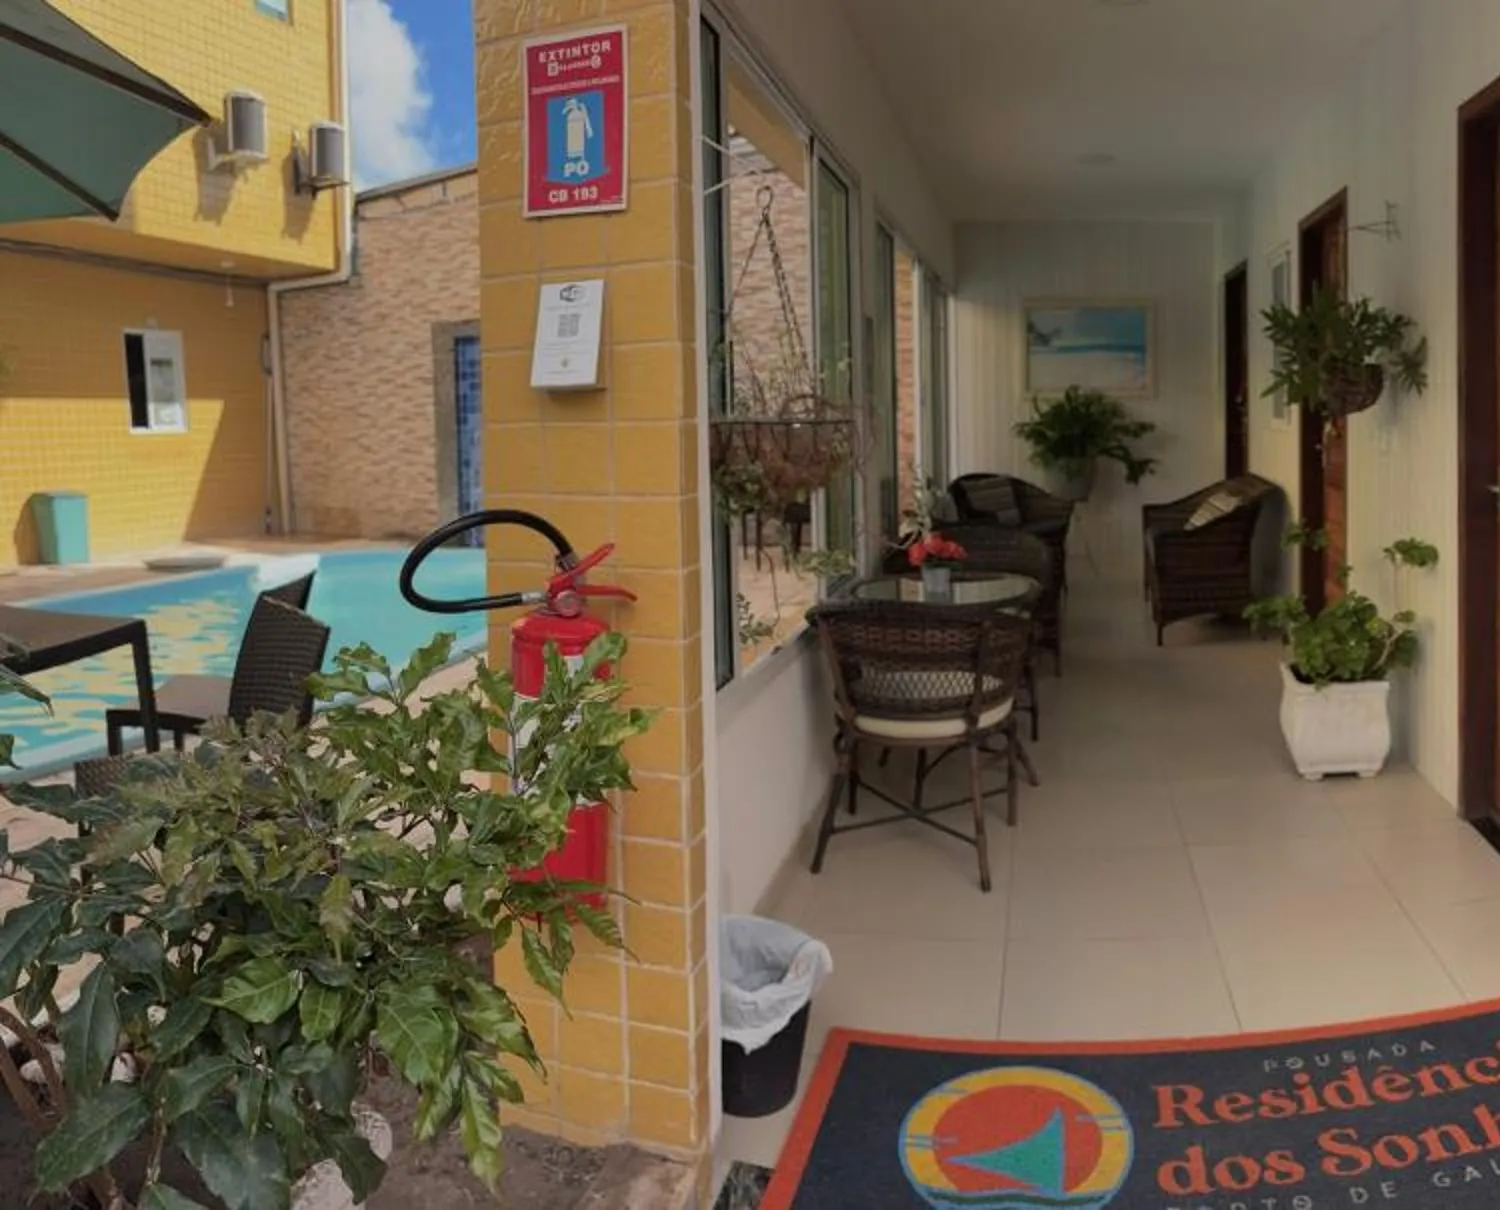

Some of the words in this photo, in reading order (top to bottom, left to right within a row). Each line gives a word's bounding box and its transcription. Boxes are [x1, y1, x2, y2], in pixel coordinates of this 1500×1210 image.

[538, 40, 612, 64] EXTINTOR
[1263, 1040, 1436, 1073] POUSADA
[1156, 1146, 1306, 1195] dos
[1349, 1181, 1397, 1204] DE
